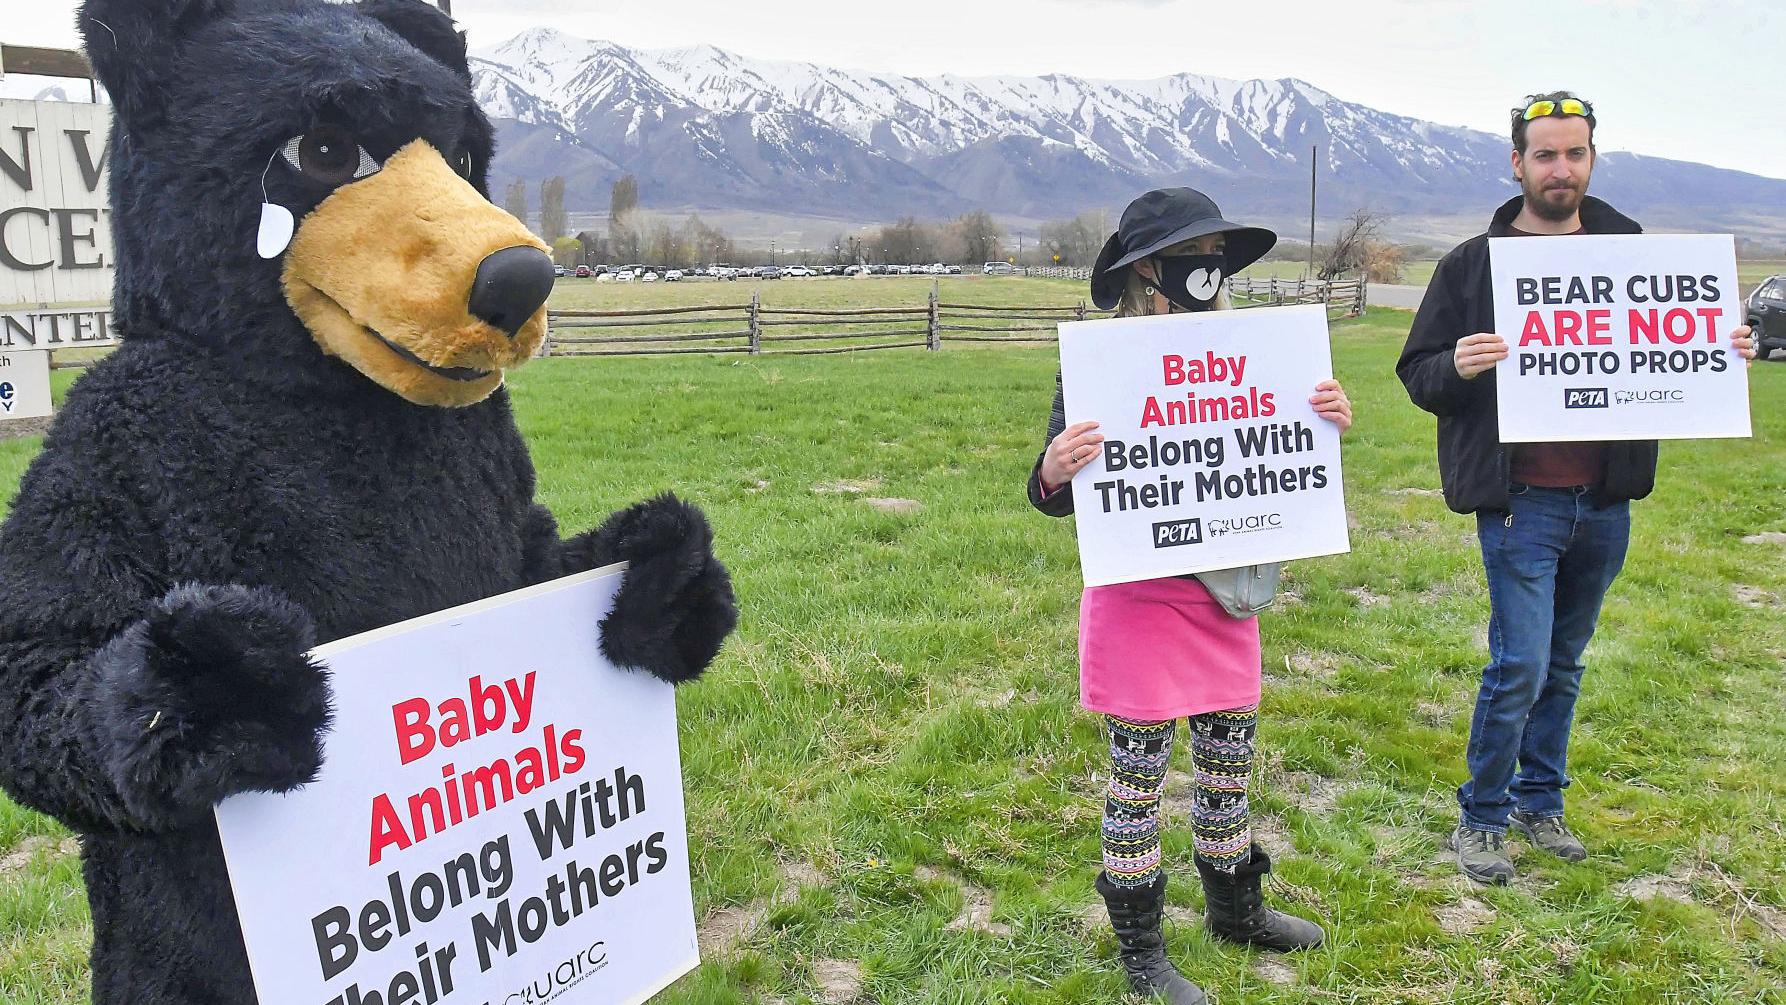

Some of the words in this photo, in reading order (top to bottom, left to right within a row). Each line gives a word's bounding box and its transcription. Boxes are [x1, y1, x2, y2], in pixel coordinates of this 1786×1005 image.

[0, 207, 112, 271] CE
[1516, 276, 1614, 305] BEAR
[1627, 275, 1721, 303] CUBS
[1519, 310, 1612, 346] ARE
[1628, 308, 1723, 345] NOT
[1163, 351, 1247, 387] Baby
[1520, 352, 1620, 376] PHOTO
[1631, 350, 1728, 374] PROPS
[1140, 387, 1276, 429] Animals
[1104, 436, 1225, 472] Belong
[1234, 422, 1314, 458] With
[1094, 474, 1185, 513] Their
[1195, 463, 1328, 502] Mothers
[392, 671, 537, 766] Baby
[369, 724, 586, 866] Animals
[311, 834, 514, 982] Belong
[524, 766, 646, 861] With
[471, 832, 668, 973] Mothers
